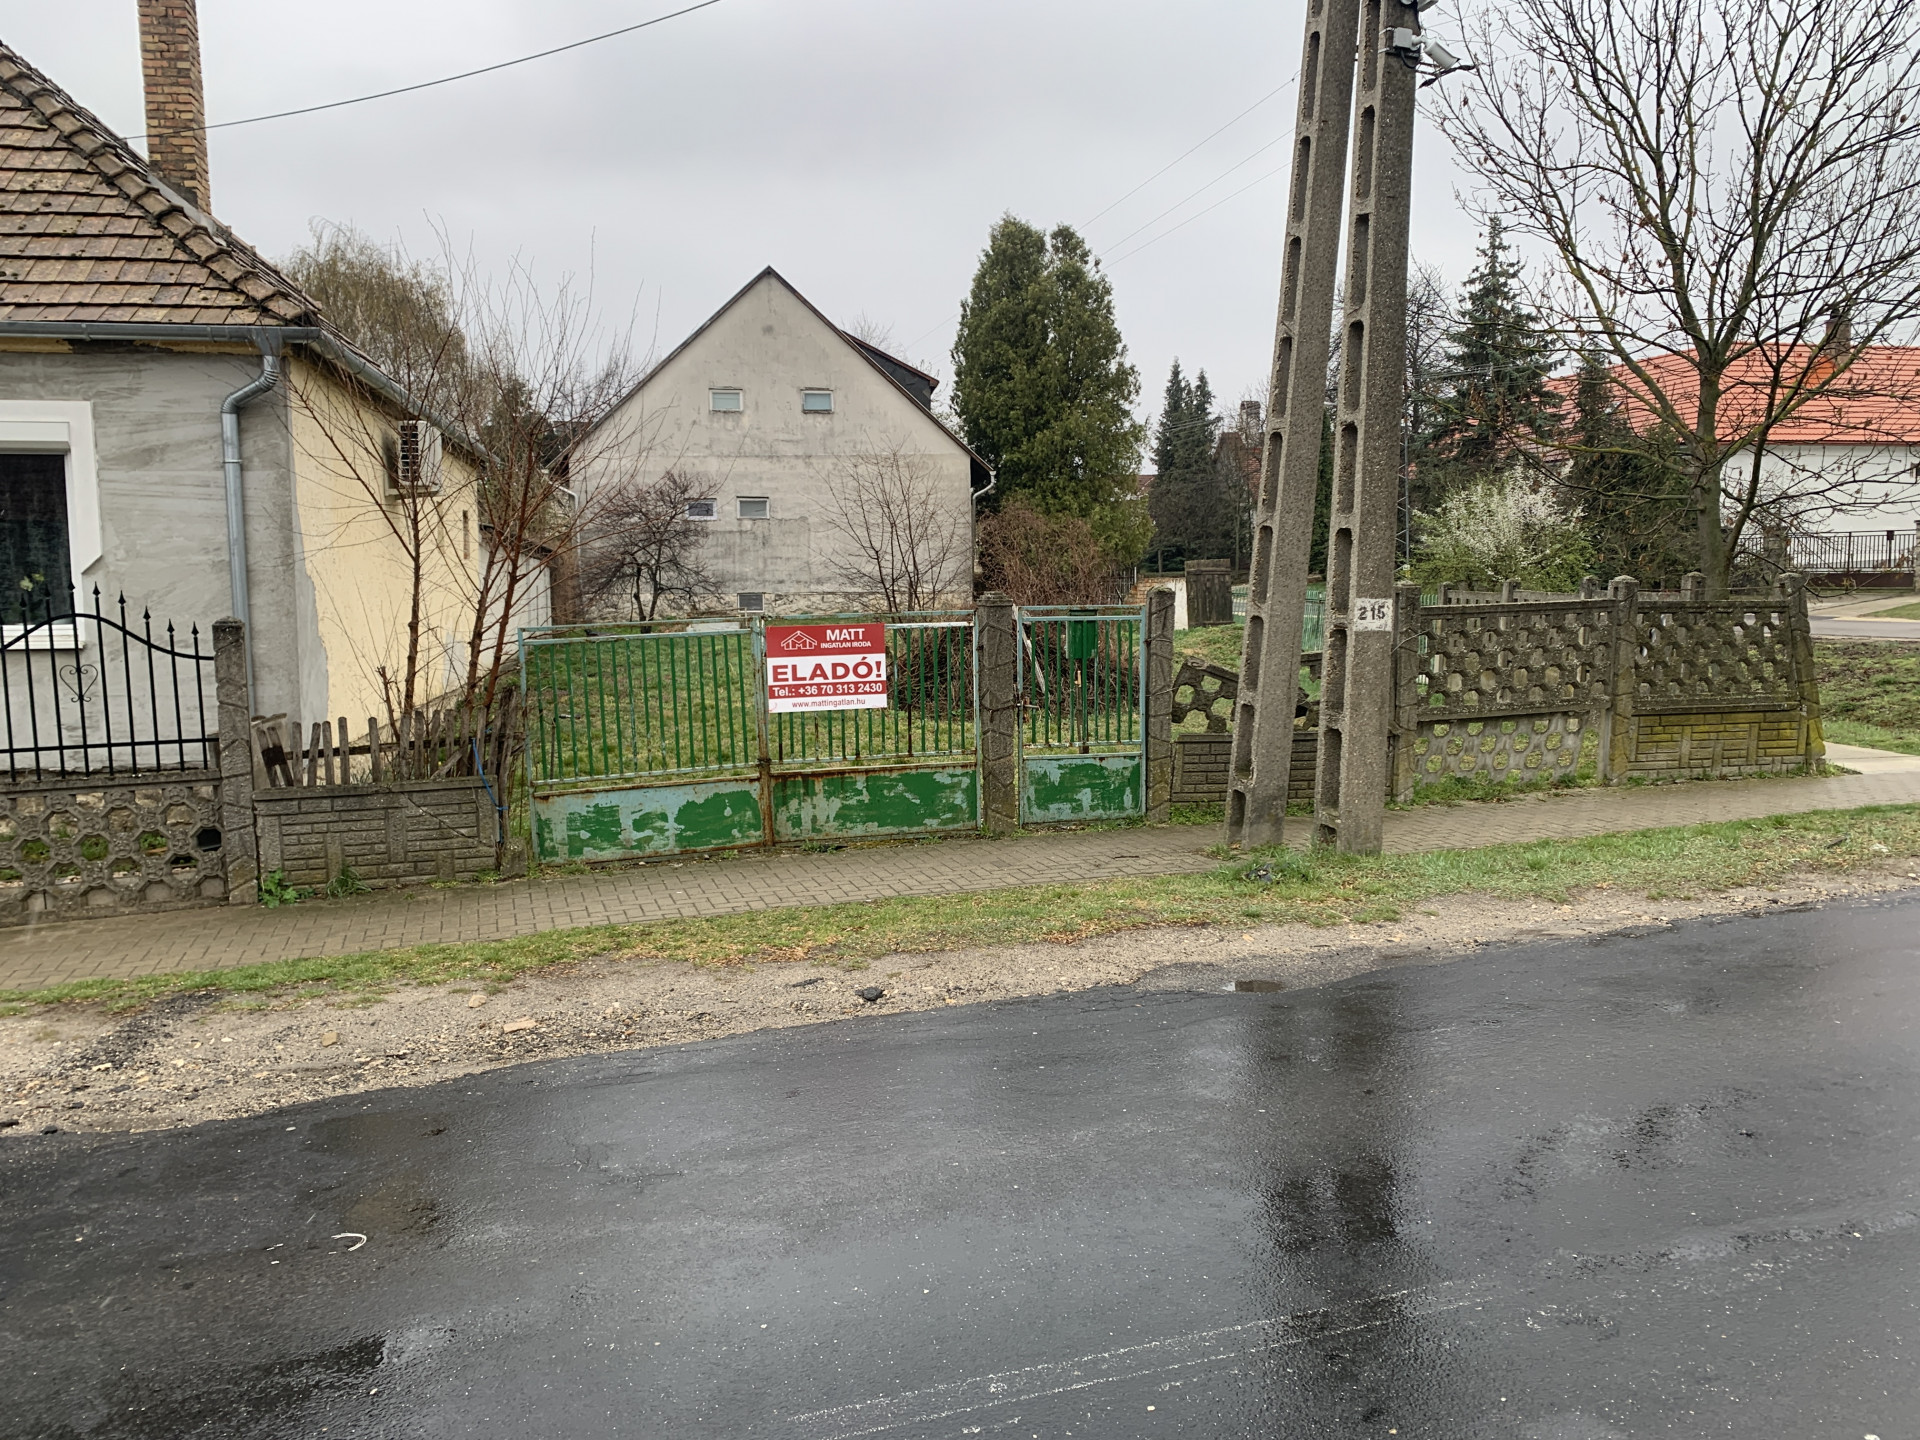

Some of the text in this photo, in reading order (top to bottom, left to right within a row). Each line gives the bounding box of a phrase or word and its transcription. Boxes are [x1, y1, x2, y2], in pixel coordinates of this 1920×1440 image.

[1358, 605, 1385, 620] 215
[826, 628, 865, 641] MATT
[772, 656, 882, 682] ELADÓ!
[772, 682, 883, 697] Tel.: +36 70 313 2430
[792, 698, 866, 708] www.mattingatlan.hu
